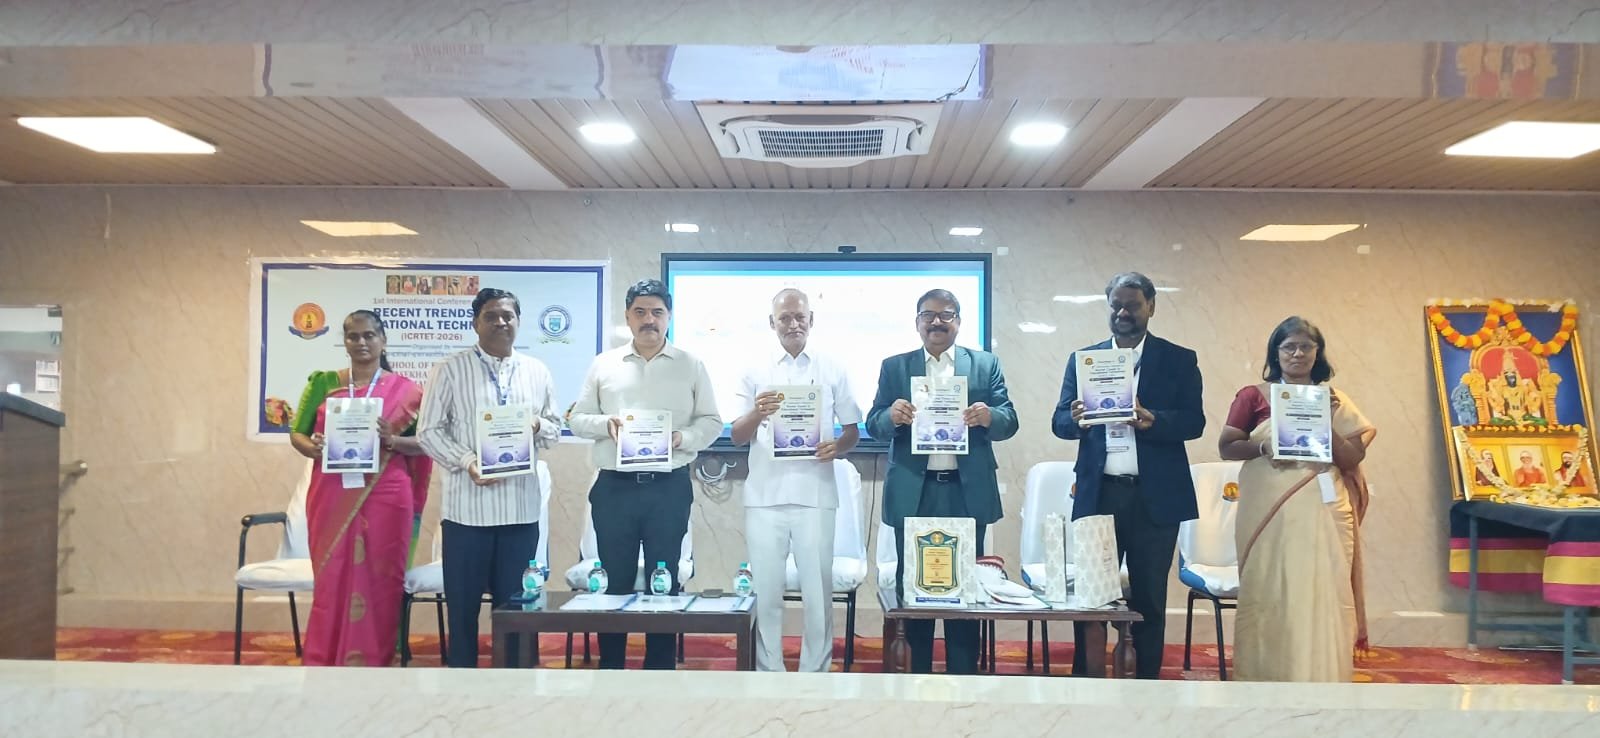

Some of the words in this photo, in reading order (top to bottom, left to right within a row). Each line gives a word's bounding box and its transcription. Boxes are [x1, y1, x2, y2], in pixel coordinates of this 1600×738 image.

[437, 297, 473, 305] Conferen
[373, 307, 421, 318] RECENT
[425, 308, 475, 318] TRENDS
[382, 319, 433, 330] ATIONAL
[392, 361, 416, 369] HOOL
